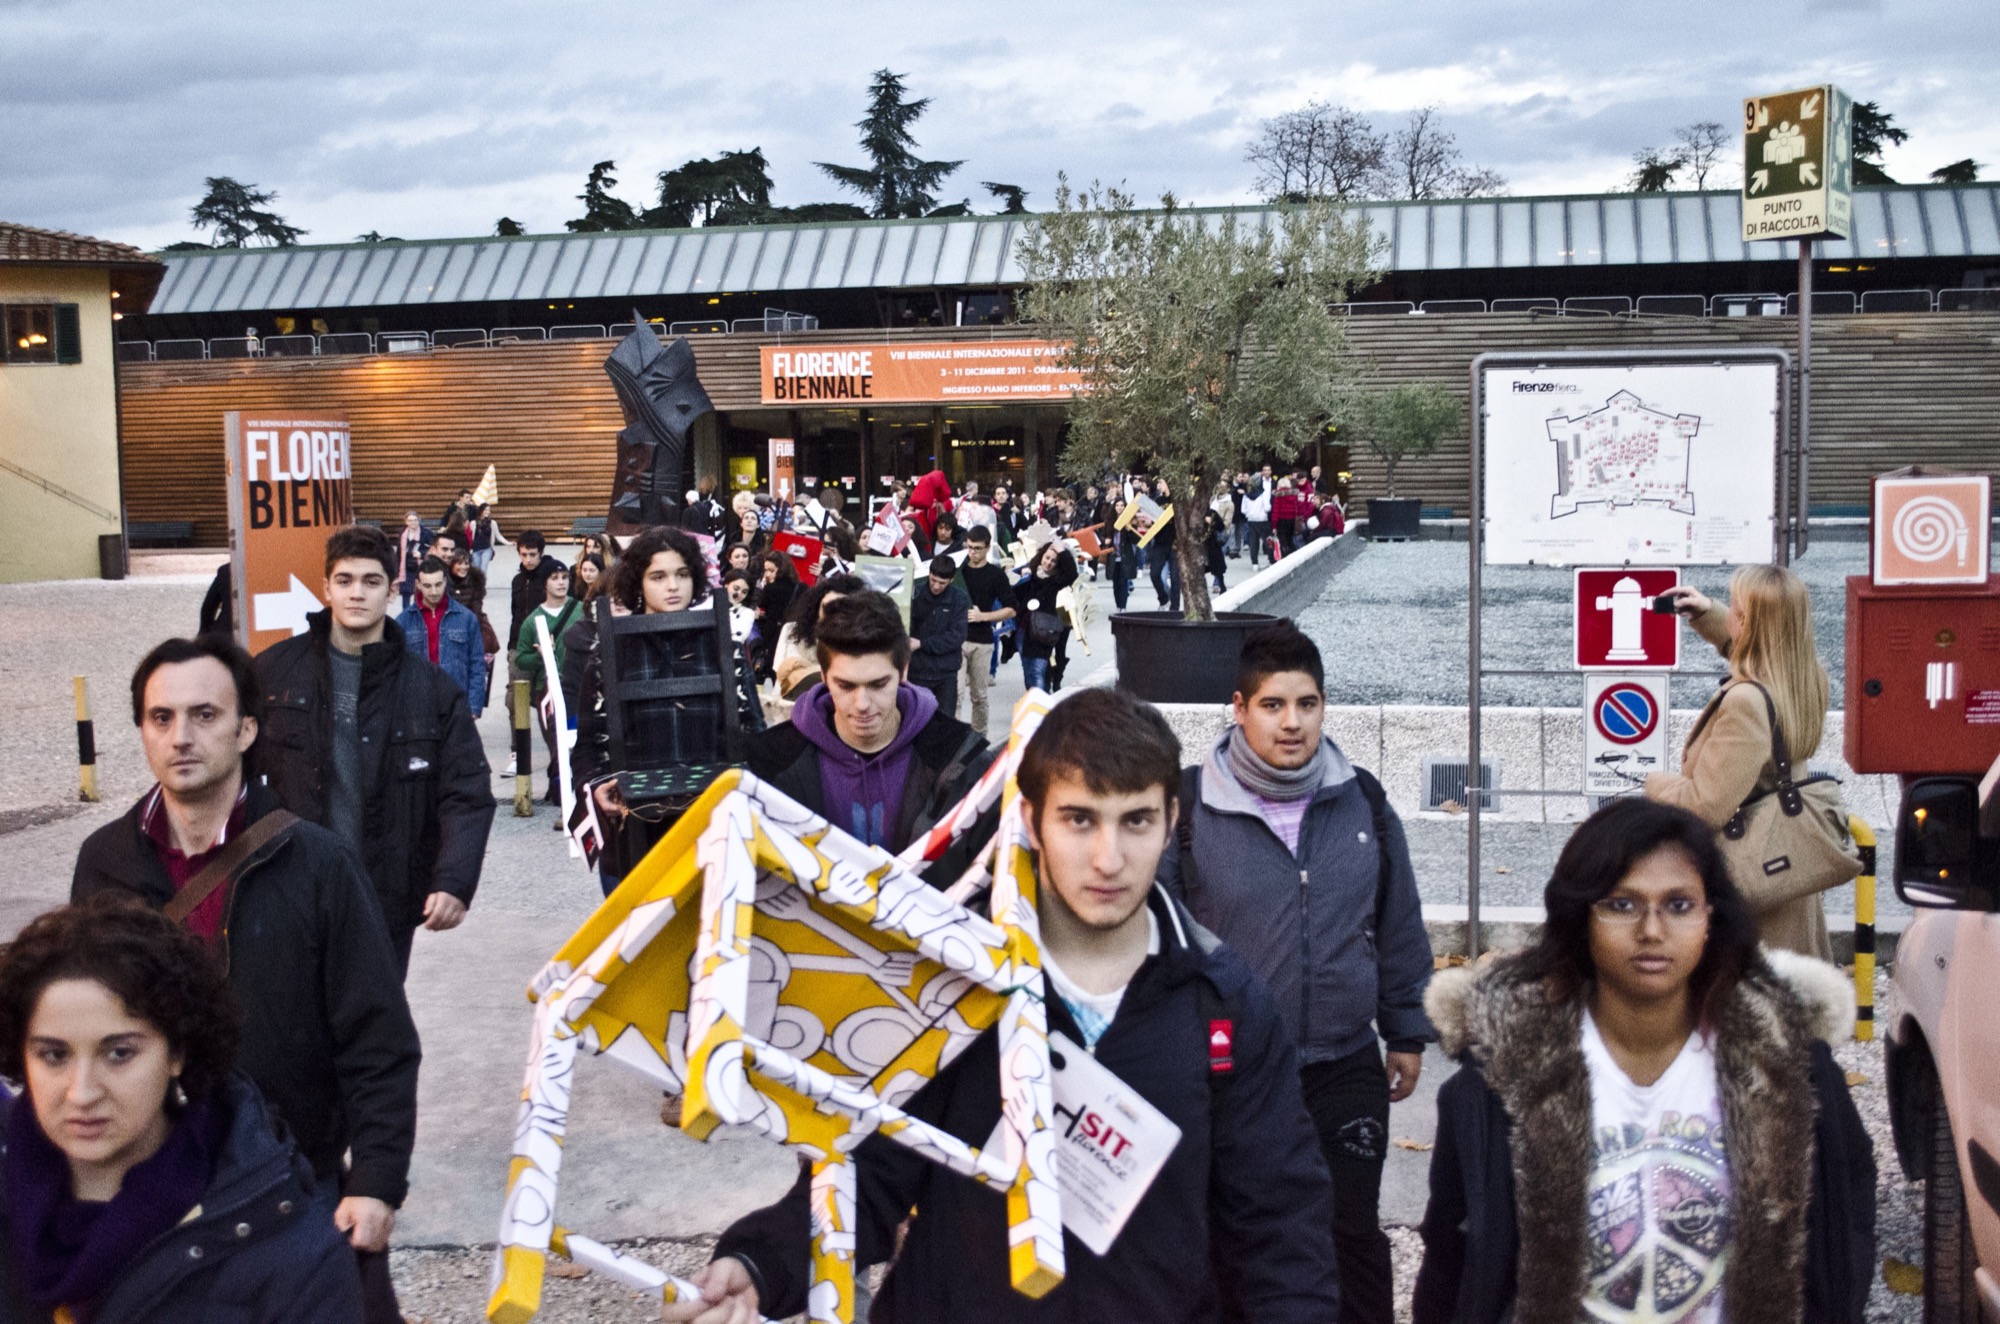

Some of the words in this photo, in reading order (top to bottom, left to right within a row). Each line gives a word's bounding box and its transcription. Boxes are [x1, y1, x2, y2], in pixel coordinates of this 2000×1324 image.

[1746, 101, 1755, 130] 9
[1763, 199, 1802, 215] PUNTO
[1746, 224, 1757, 236] DI
[1760, 215, 1820, 234] RACCOLTA
[890, 351, 906, 360] VIII
[907, 350, 952, 360] BIENNALE
[953, 347, 1032, 359] INTERNAZIONALE
[773, 351, 873, 378] FLORENCE
[940, 368, 947, 376] 3
[954, 367, 963, 376] 11
[965, 366, 1006, 376] DICEMBRE
[1007, 366, 1026, 375] 2011
[774, 375, 873, 399] BIENNALE
[942, 386, 982, 394] INGRESSO
[983, 385, 1010, 393] PIANO
[1011, 384, 1052, 393] INFERIORE
[1081, 1112, 1132, 1158] SIT
